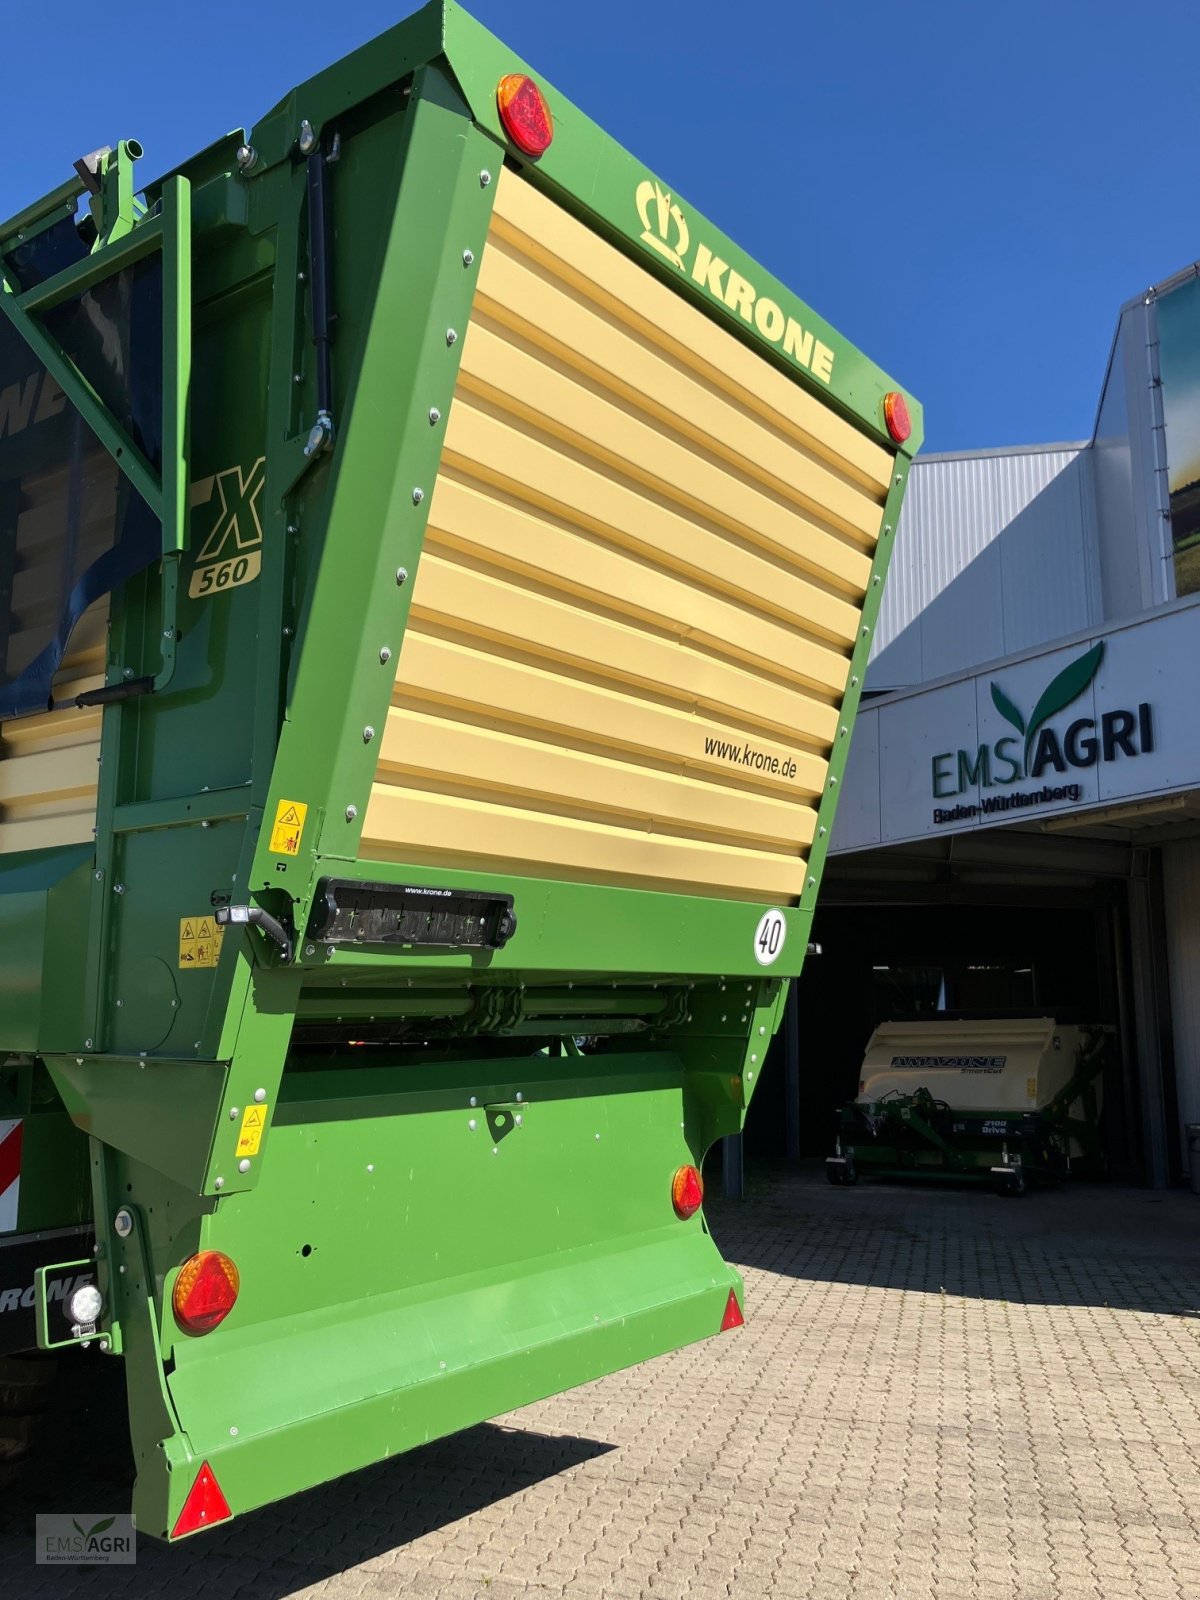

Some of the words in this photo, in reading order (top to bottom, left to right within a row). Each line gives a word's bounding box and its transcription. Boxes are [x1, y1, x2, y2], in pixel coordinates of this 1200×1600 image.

[692, 243, 834, 384] KRONE
[198, 557, 249, 593] 560
[705, 737, 797, 779] www.krone.de
[1031, 702, 1154, 778] AGRI
[933, 783, 1080, 824] Baden-Württemberg
[404, 887, 452, 897] www.krone.de
[759, 918, 782, 955] 40
[891, 1056, 1006, 1068] AMAZONE
